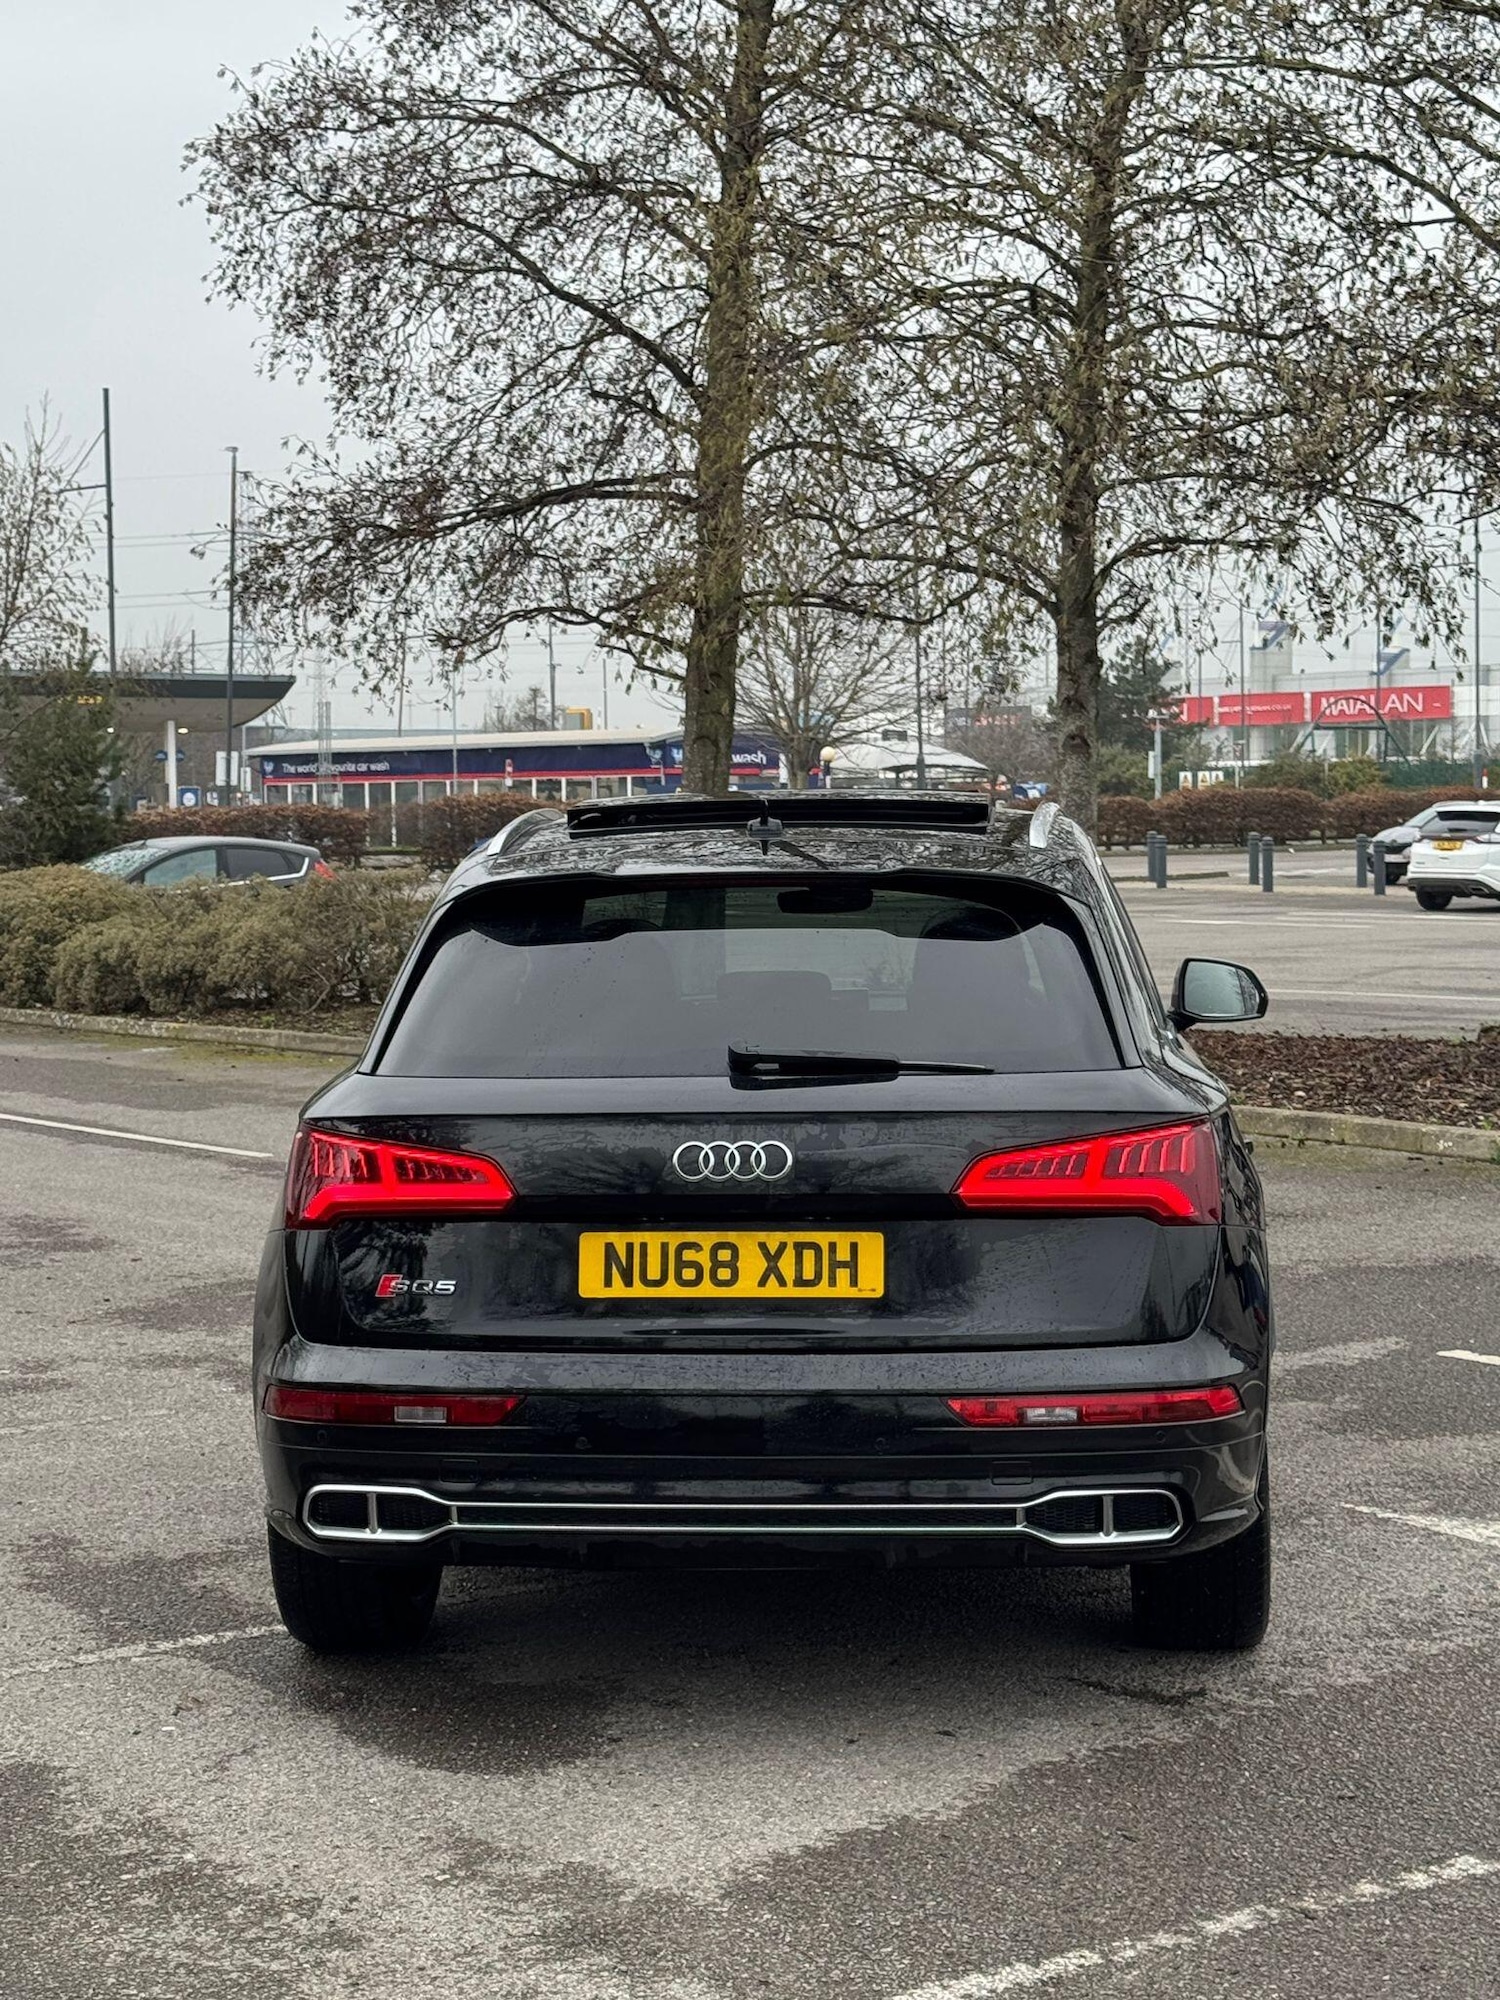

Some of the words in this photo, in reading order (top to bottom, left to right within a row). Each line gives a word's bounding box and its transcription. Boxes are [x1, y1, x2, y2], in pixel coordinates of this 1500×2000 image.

[1320, 692, 1423, 716] MATALAN
[731, 751, 767, 765] wash
[281, 763, 296, 774] The
[603, 1241, 739, 1288] NU68
[757, 1241, 859, 1288] XDH
[387, 1279, 457, 1295] SQ5
